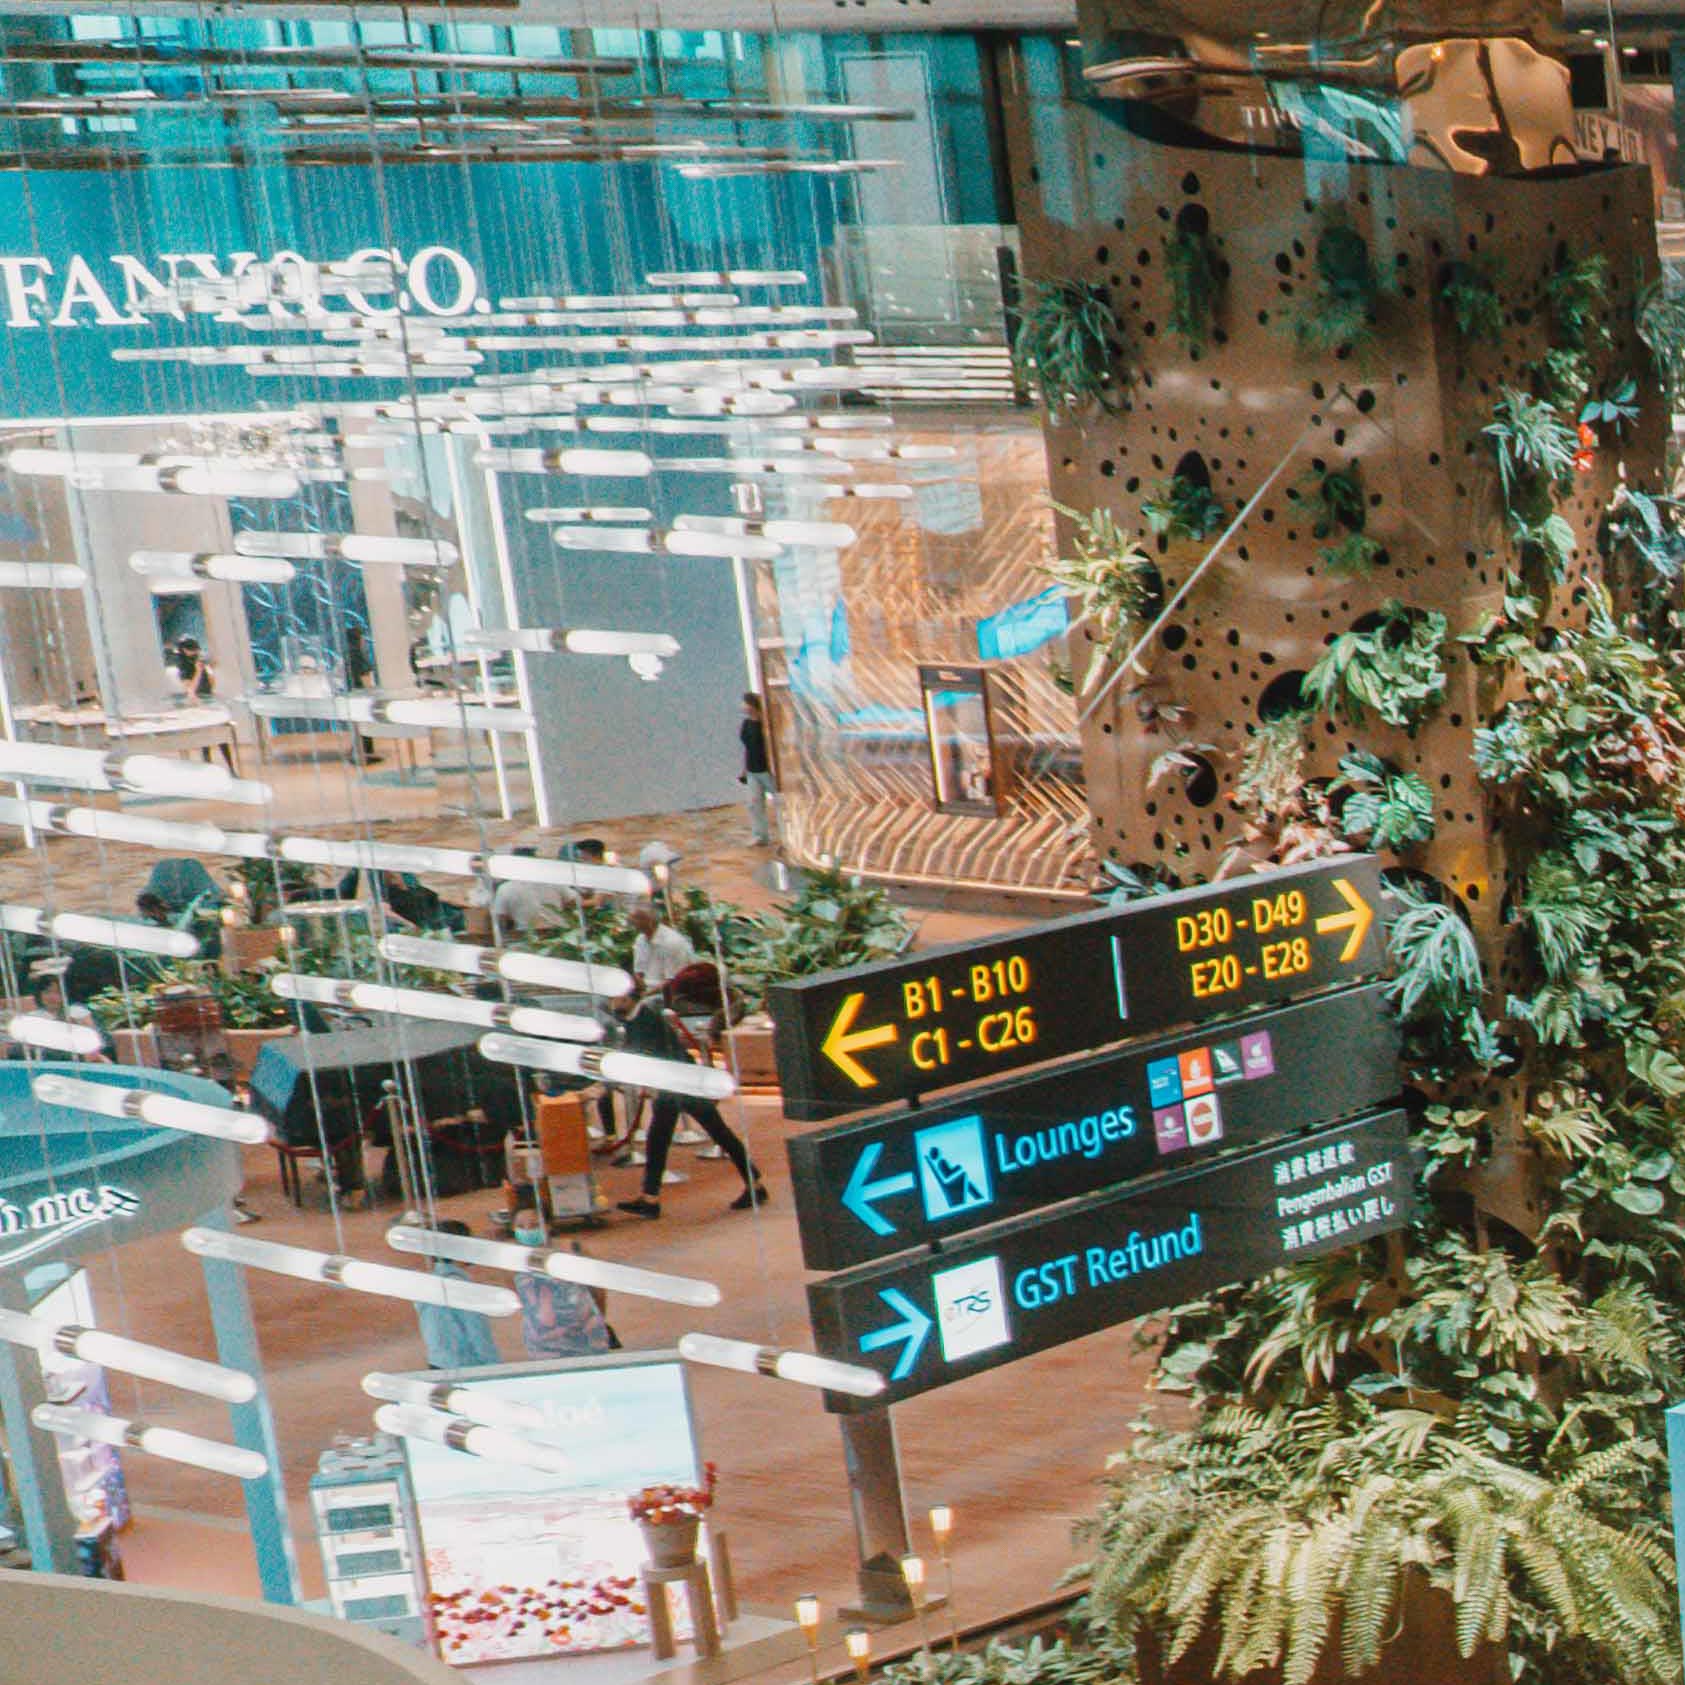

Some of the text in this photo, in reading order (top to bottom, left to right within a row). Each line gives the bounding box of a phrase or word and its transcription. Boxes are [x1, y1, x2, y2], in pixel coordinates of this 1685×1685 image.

[1176, 907, 1233, 952] D30
[1252, 889, 1308, 934] D49
[903, 976, 943, 1019] B1
[970, 955, 1030, 1003] B10
[1190, 954, 1243, 998] E20
[1261, 937, 1313, 980] E28
[911, 1027, 950, 1070] C1
[977, 1005, 1039, 1053] C26
[995, 1104, 1137, 1174] Lounges
[1366, 1161, 1394, 1187] GST
[1013, 1209, 1204, 1310] GST Refund
